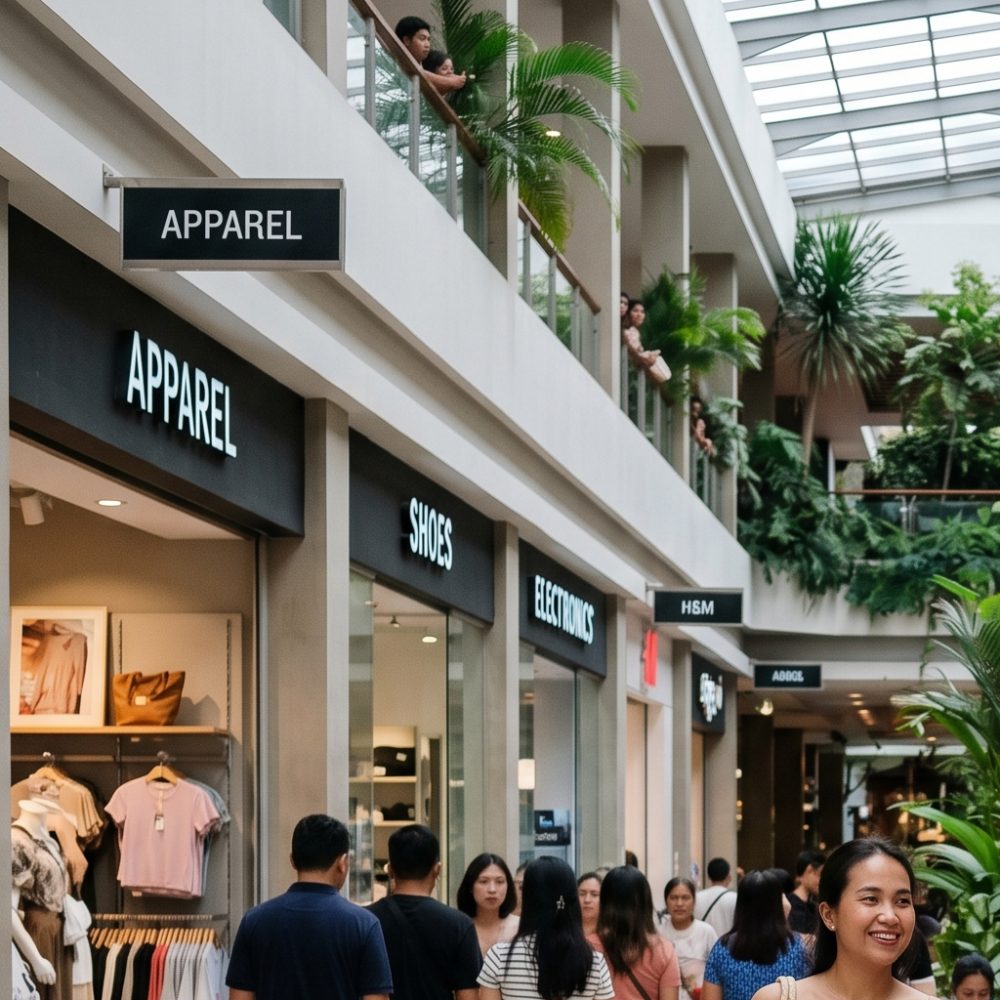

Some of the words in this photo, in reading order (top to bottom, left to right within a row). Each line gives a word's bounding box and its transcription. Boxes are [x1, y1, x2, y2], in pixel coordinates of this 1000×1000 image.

[161, 209, 303, 240] APPAREL
[126, 330, 237, 458] APPAREL
[409, 496, 453, 571] SHOES
[534, 574, 595, 645] ELECTRONICS
